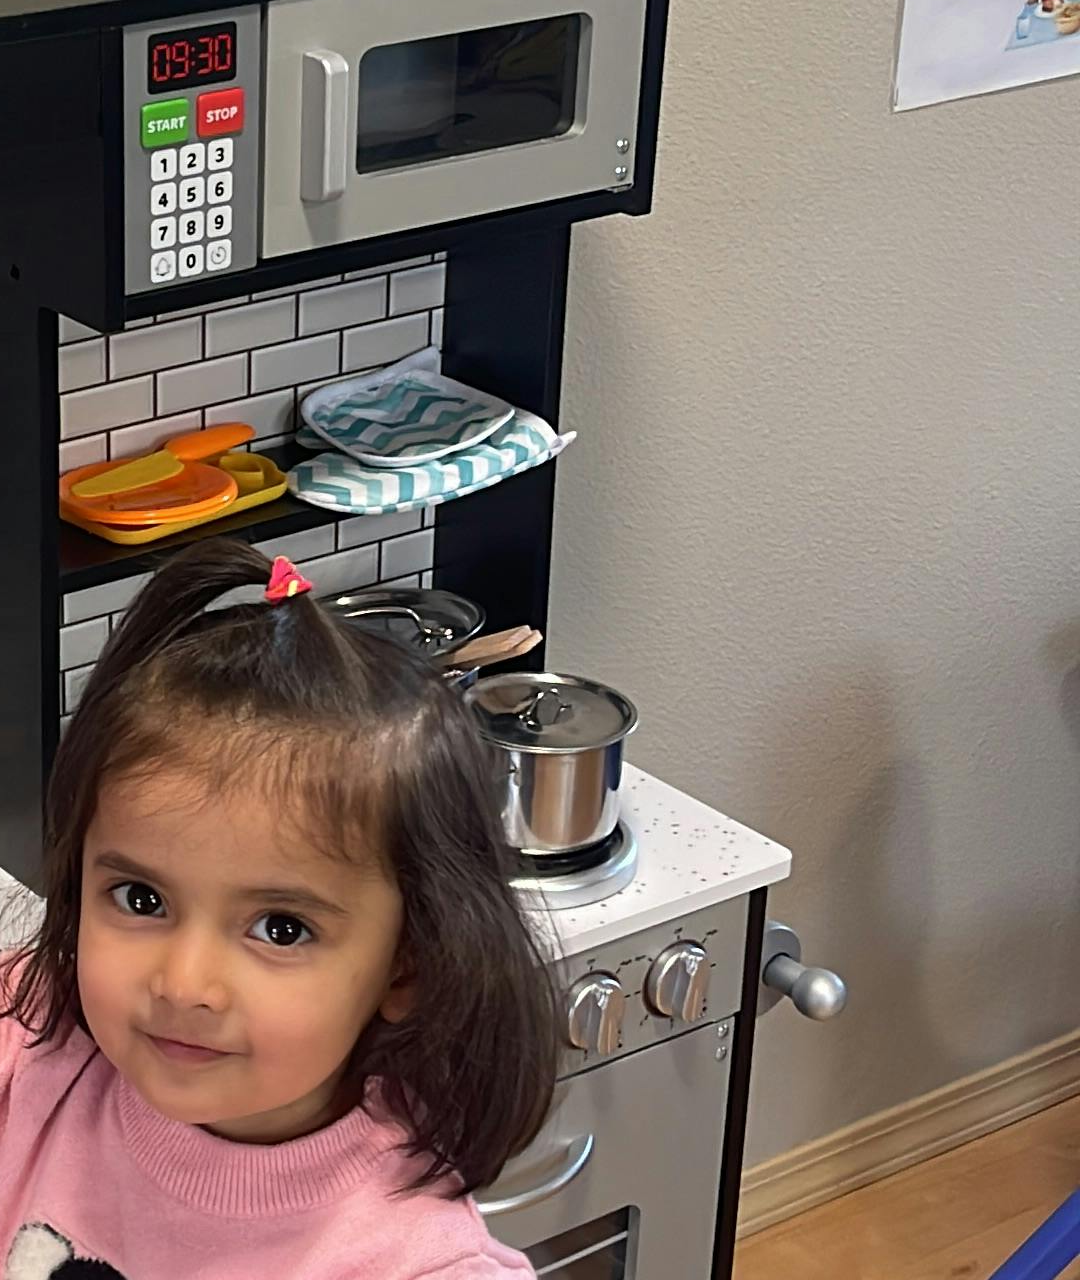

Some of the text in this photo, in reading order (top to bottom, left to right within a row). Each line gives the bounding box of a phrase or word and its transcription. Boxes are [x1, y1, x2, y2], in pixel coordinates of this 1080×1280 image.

[152, 33, 232, 82] 09:30
[147, 106, 238, 134] START STOP
[160, 147, 225, 173] 1 2 3
[158, 181, 225, 208] 4 5 6
[158, 214, 225, 241] 7 8 9
[186, 253, 197, 269] 0
